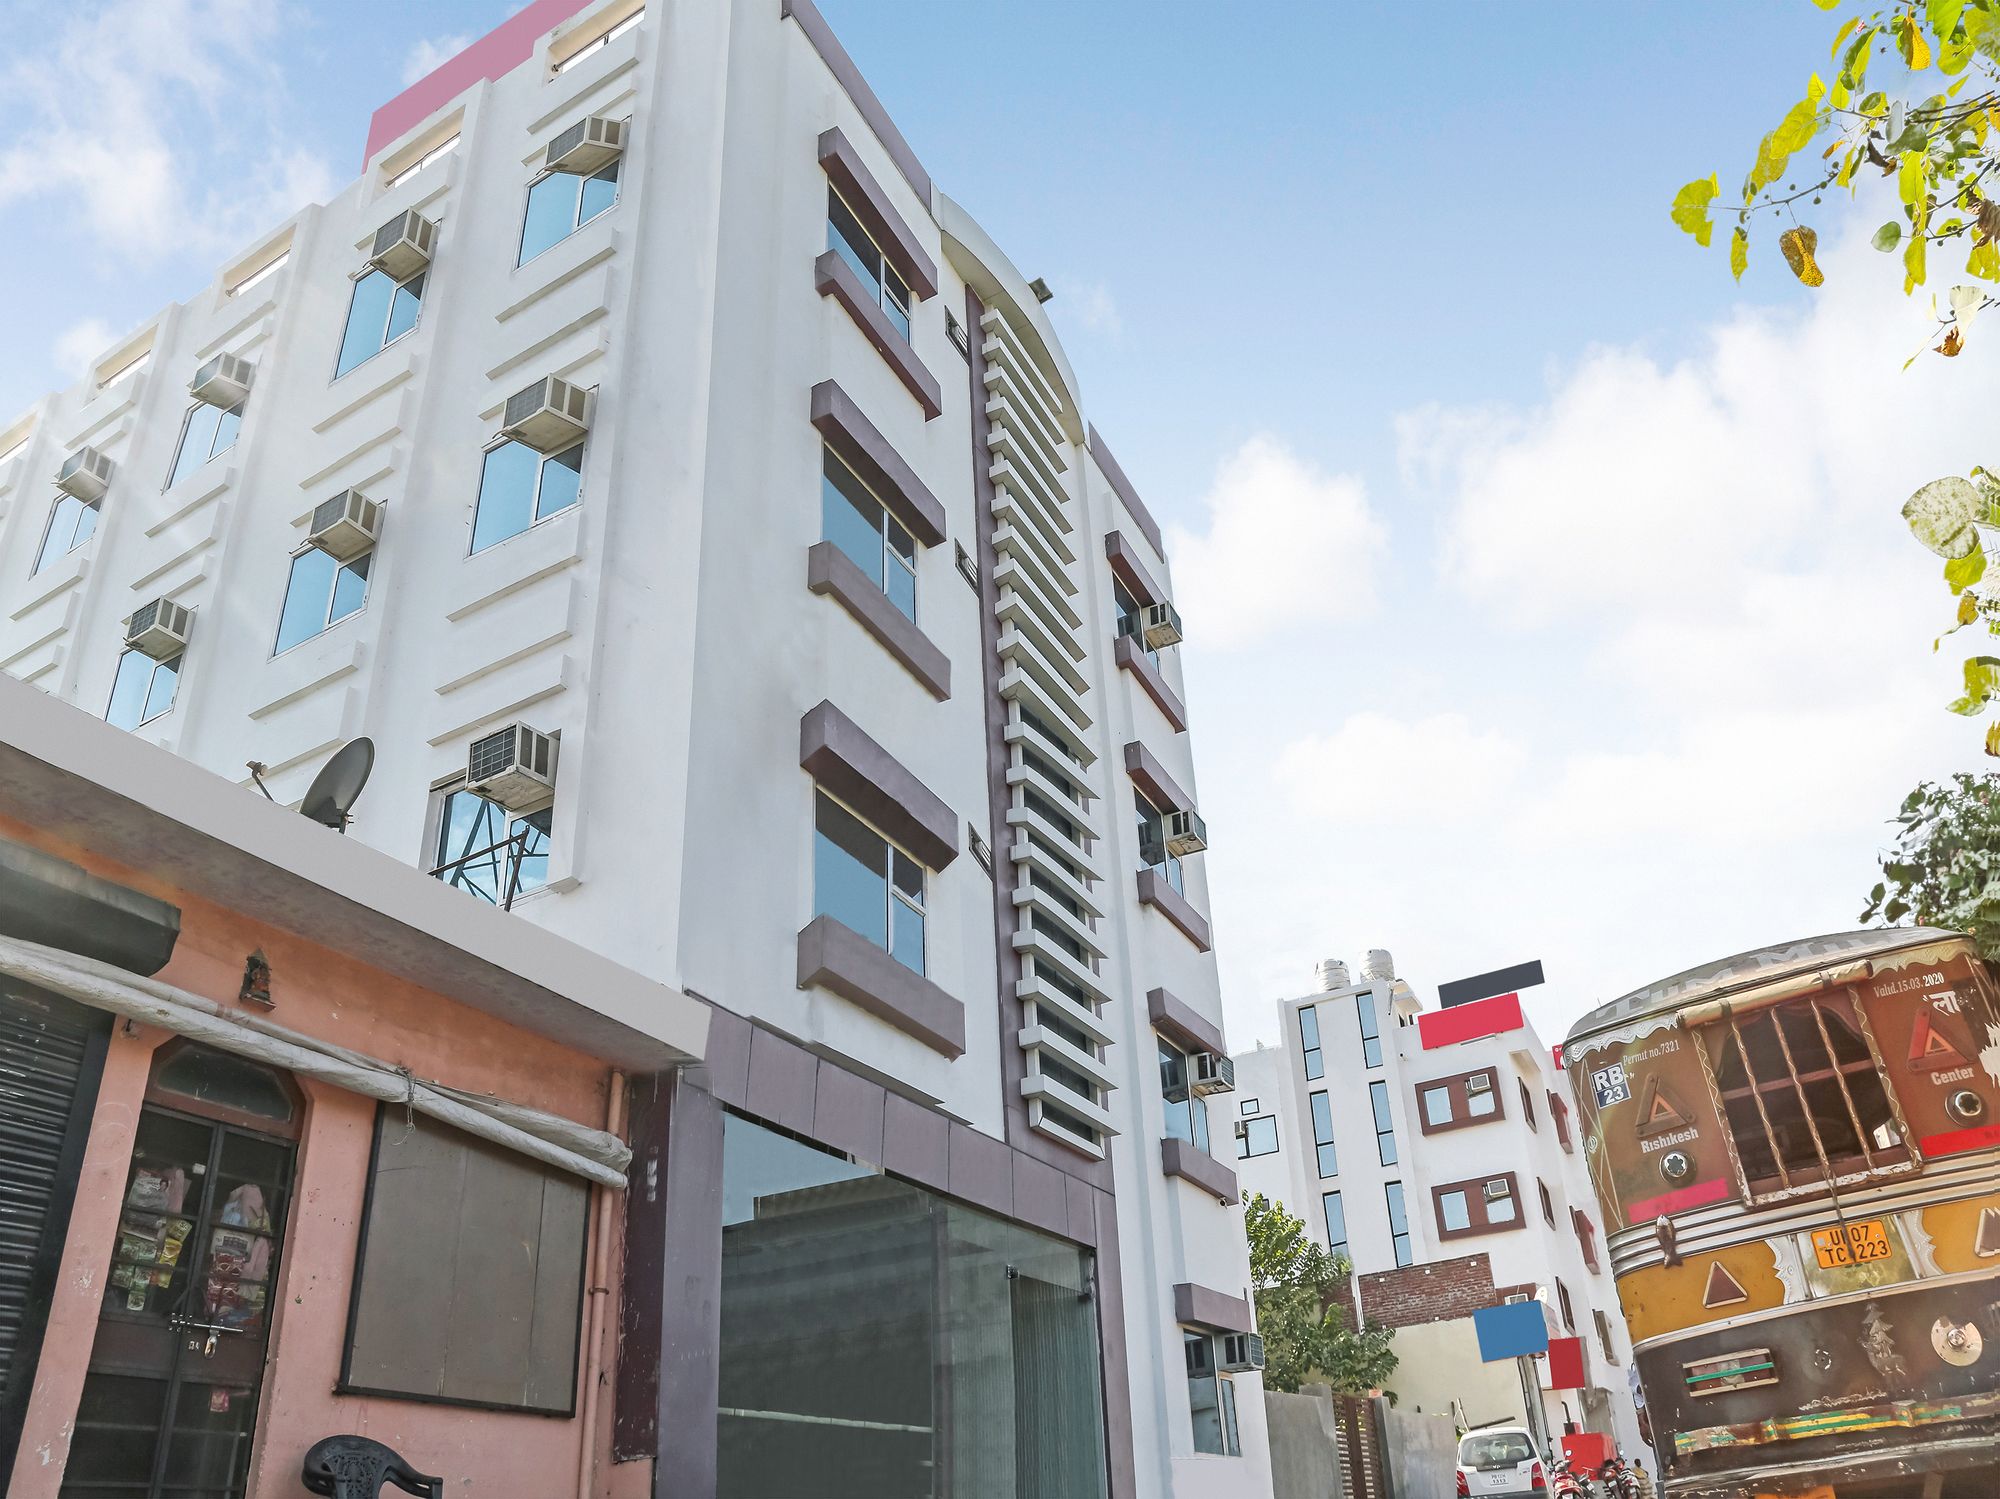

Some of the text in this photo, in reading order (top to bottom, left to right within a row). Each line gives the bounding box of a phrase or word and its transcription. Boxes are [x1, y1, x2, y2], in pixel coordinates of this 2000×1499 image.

[1623, 1049, 1648, 1066] Permit
[1593, 1066, 1624, 1091] RB
[1931, 1064, 1975, 1086] Center
[1603, 1086, 1624, 1104] 23
[1640, 1127, 1700, 1153] Rishikesh
